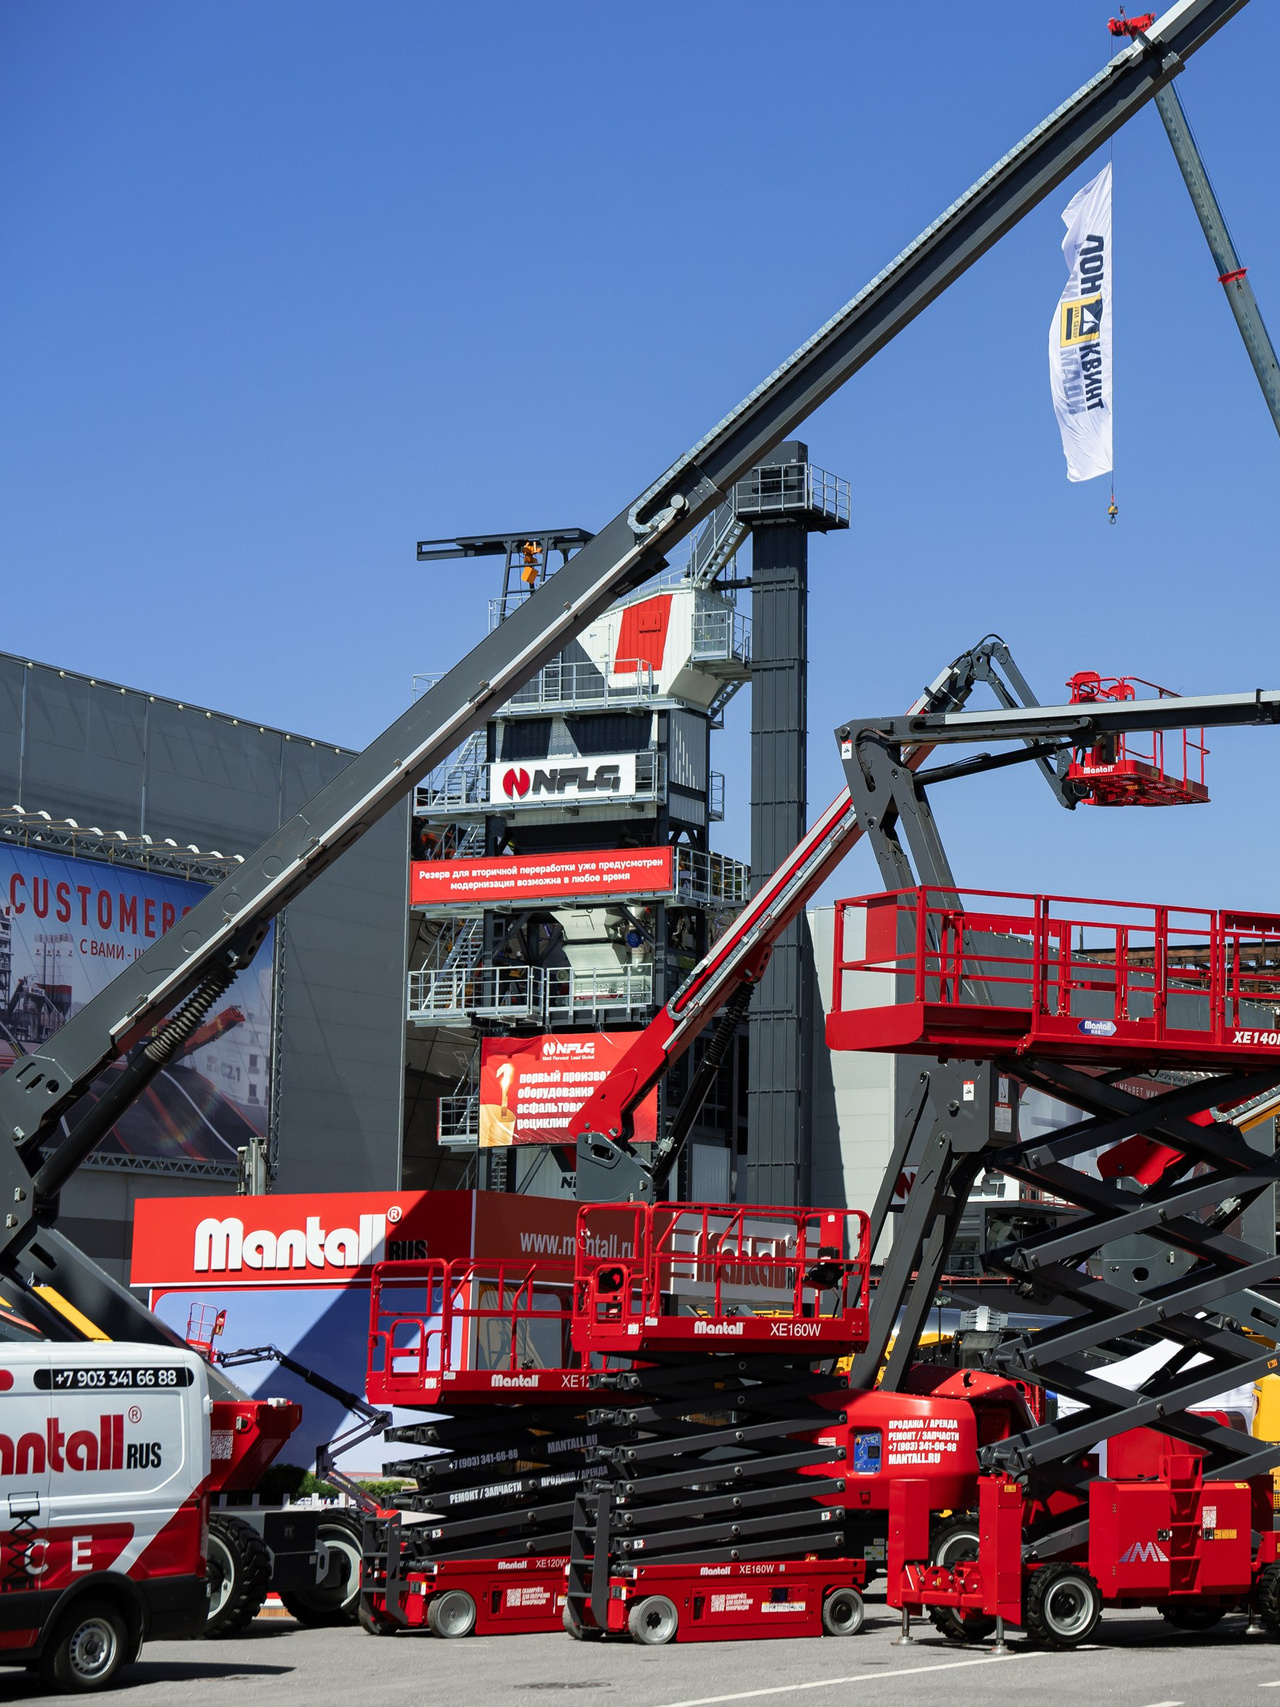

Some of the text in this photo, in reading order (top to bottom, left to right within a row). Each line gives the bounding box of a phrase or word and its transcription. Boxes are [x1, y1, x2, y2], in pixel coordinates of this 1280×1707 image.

[1079, 343, 1105, 411] КВИНТ
[1083, 765, 1115, 775] Mantall
[532, 765, 622, 796] NFLG
[419, 858, 663, 880] Резерв для вторичной переработки уже предусмотрен
[450, 872, 631, 891] модернизация возможна в любое время
[9, 872, 193, 939] CUSTOMER
[80, 938, 89, 956] С
[90, 940, 125, 961] ВАМИ
[555, 1042, 595, 1054] NFLG
[519, 1069, 612, 1084] первый произво
[517, 1086, 595, 1100] оборудования
[516, 1117, 573, 1131] рециклин
[193, 1213, 387, 1272] Mantall
[520, 1231, 635, 1260] www.mntall.ru
[694, 1320, 821, 1337] Mantall XE160W
[55, 1369, 177, 1386] +7 903 341 66 88
[490, 1374, 539, 1388] Mantall
[888, 1420, 924, 1429] ПРОДАЖА
[929, 1419, 958, 1429] АРЕНДА
[547, 1433, 599, 1454] MANTALL.RU
[888, 1432, 917, 1441] РЕМОНТ
[921, 1431, 960, 1441] ЗАПЧАСТИ
[888, 1441, 957, 1452] +7 (903) 341-66-88
[127, 1442, 162, 1470] RUS
[888, 1453, 941, 1465] MANTALL.RU
[540, 1471, 577, 1488] ПРОДАЖА
[580, 1465, 609, 1480] АРЕНДА
[449, 1489, 479, 1505] РЕМОНТ
[484, 1481, 523, 1498] ЗАПЧАСТИ
[498, 1560, 528, 1570] Mantall
[700, 1564, 775, 1576] Mantall XE160W
